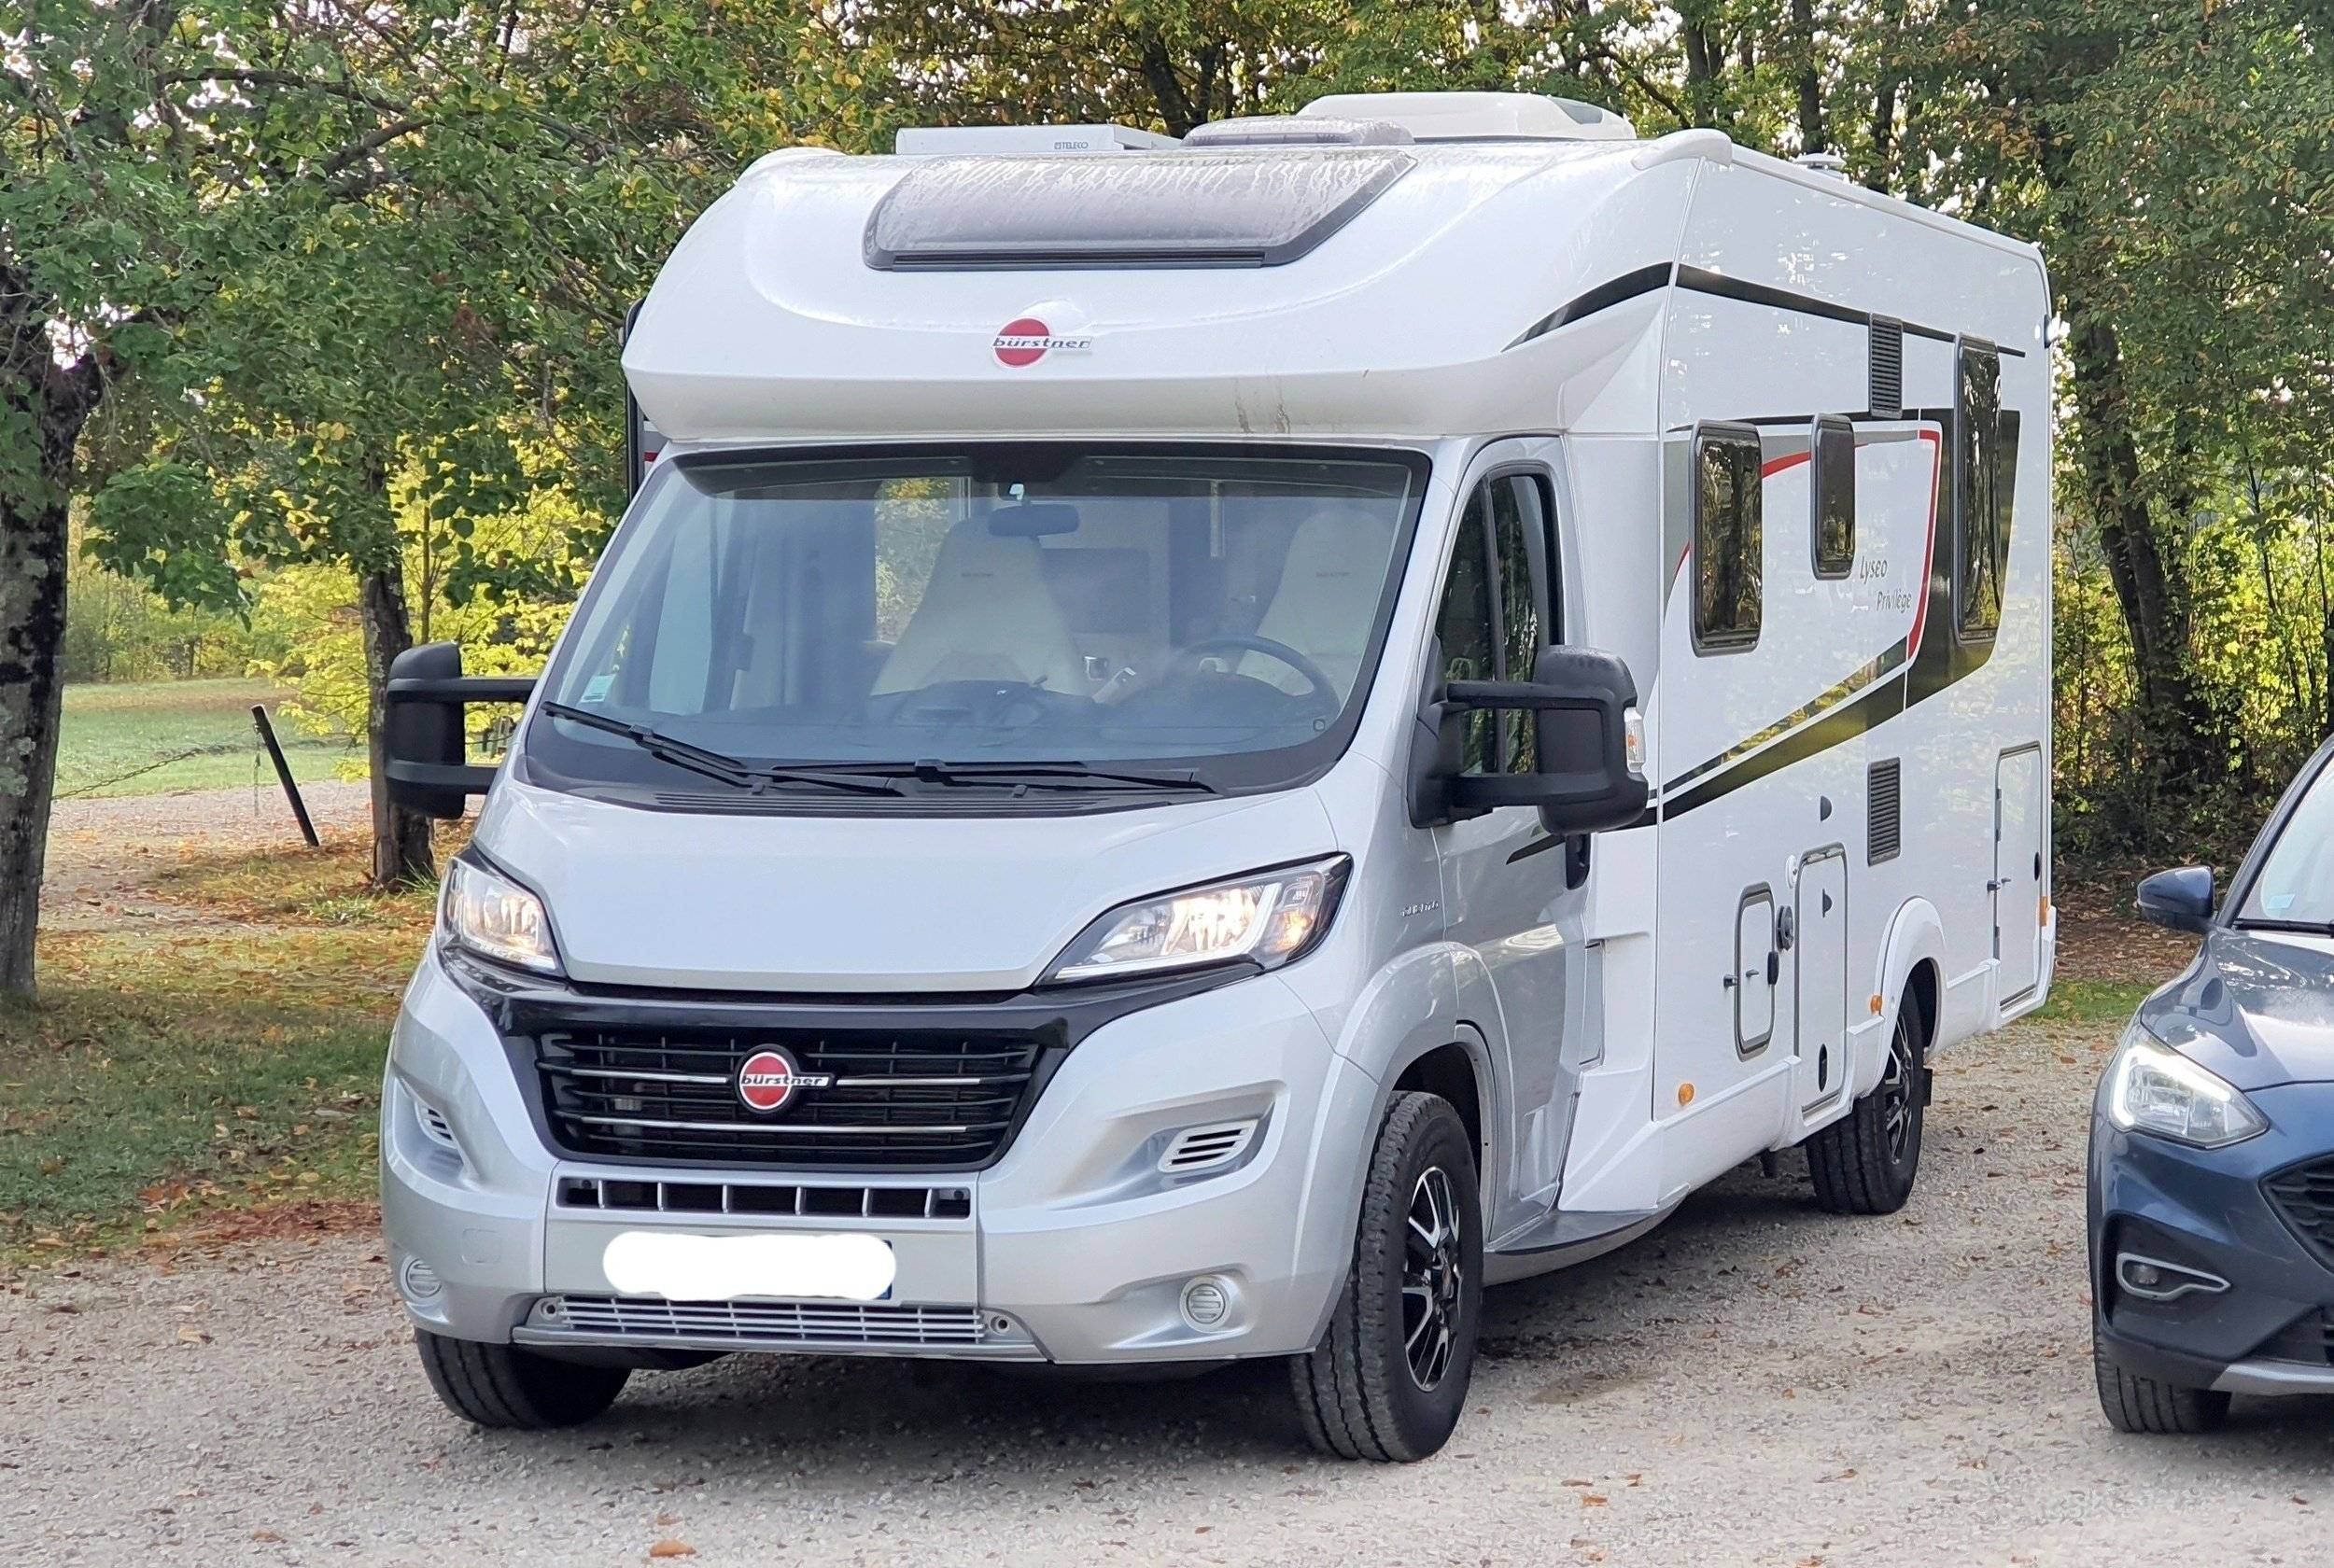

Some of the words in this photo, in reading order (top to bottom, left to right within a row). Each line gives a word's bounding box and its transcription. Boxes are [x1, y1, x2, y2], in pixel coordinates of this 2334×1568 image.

[992, 336, 1091, 349] bürstner
[1859, 555, 1888, 585] Lyseo
[1876, 589, 1912, 614] Privilège
